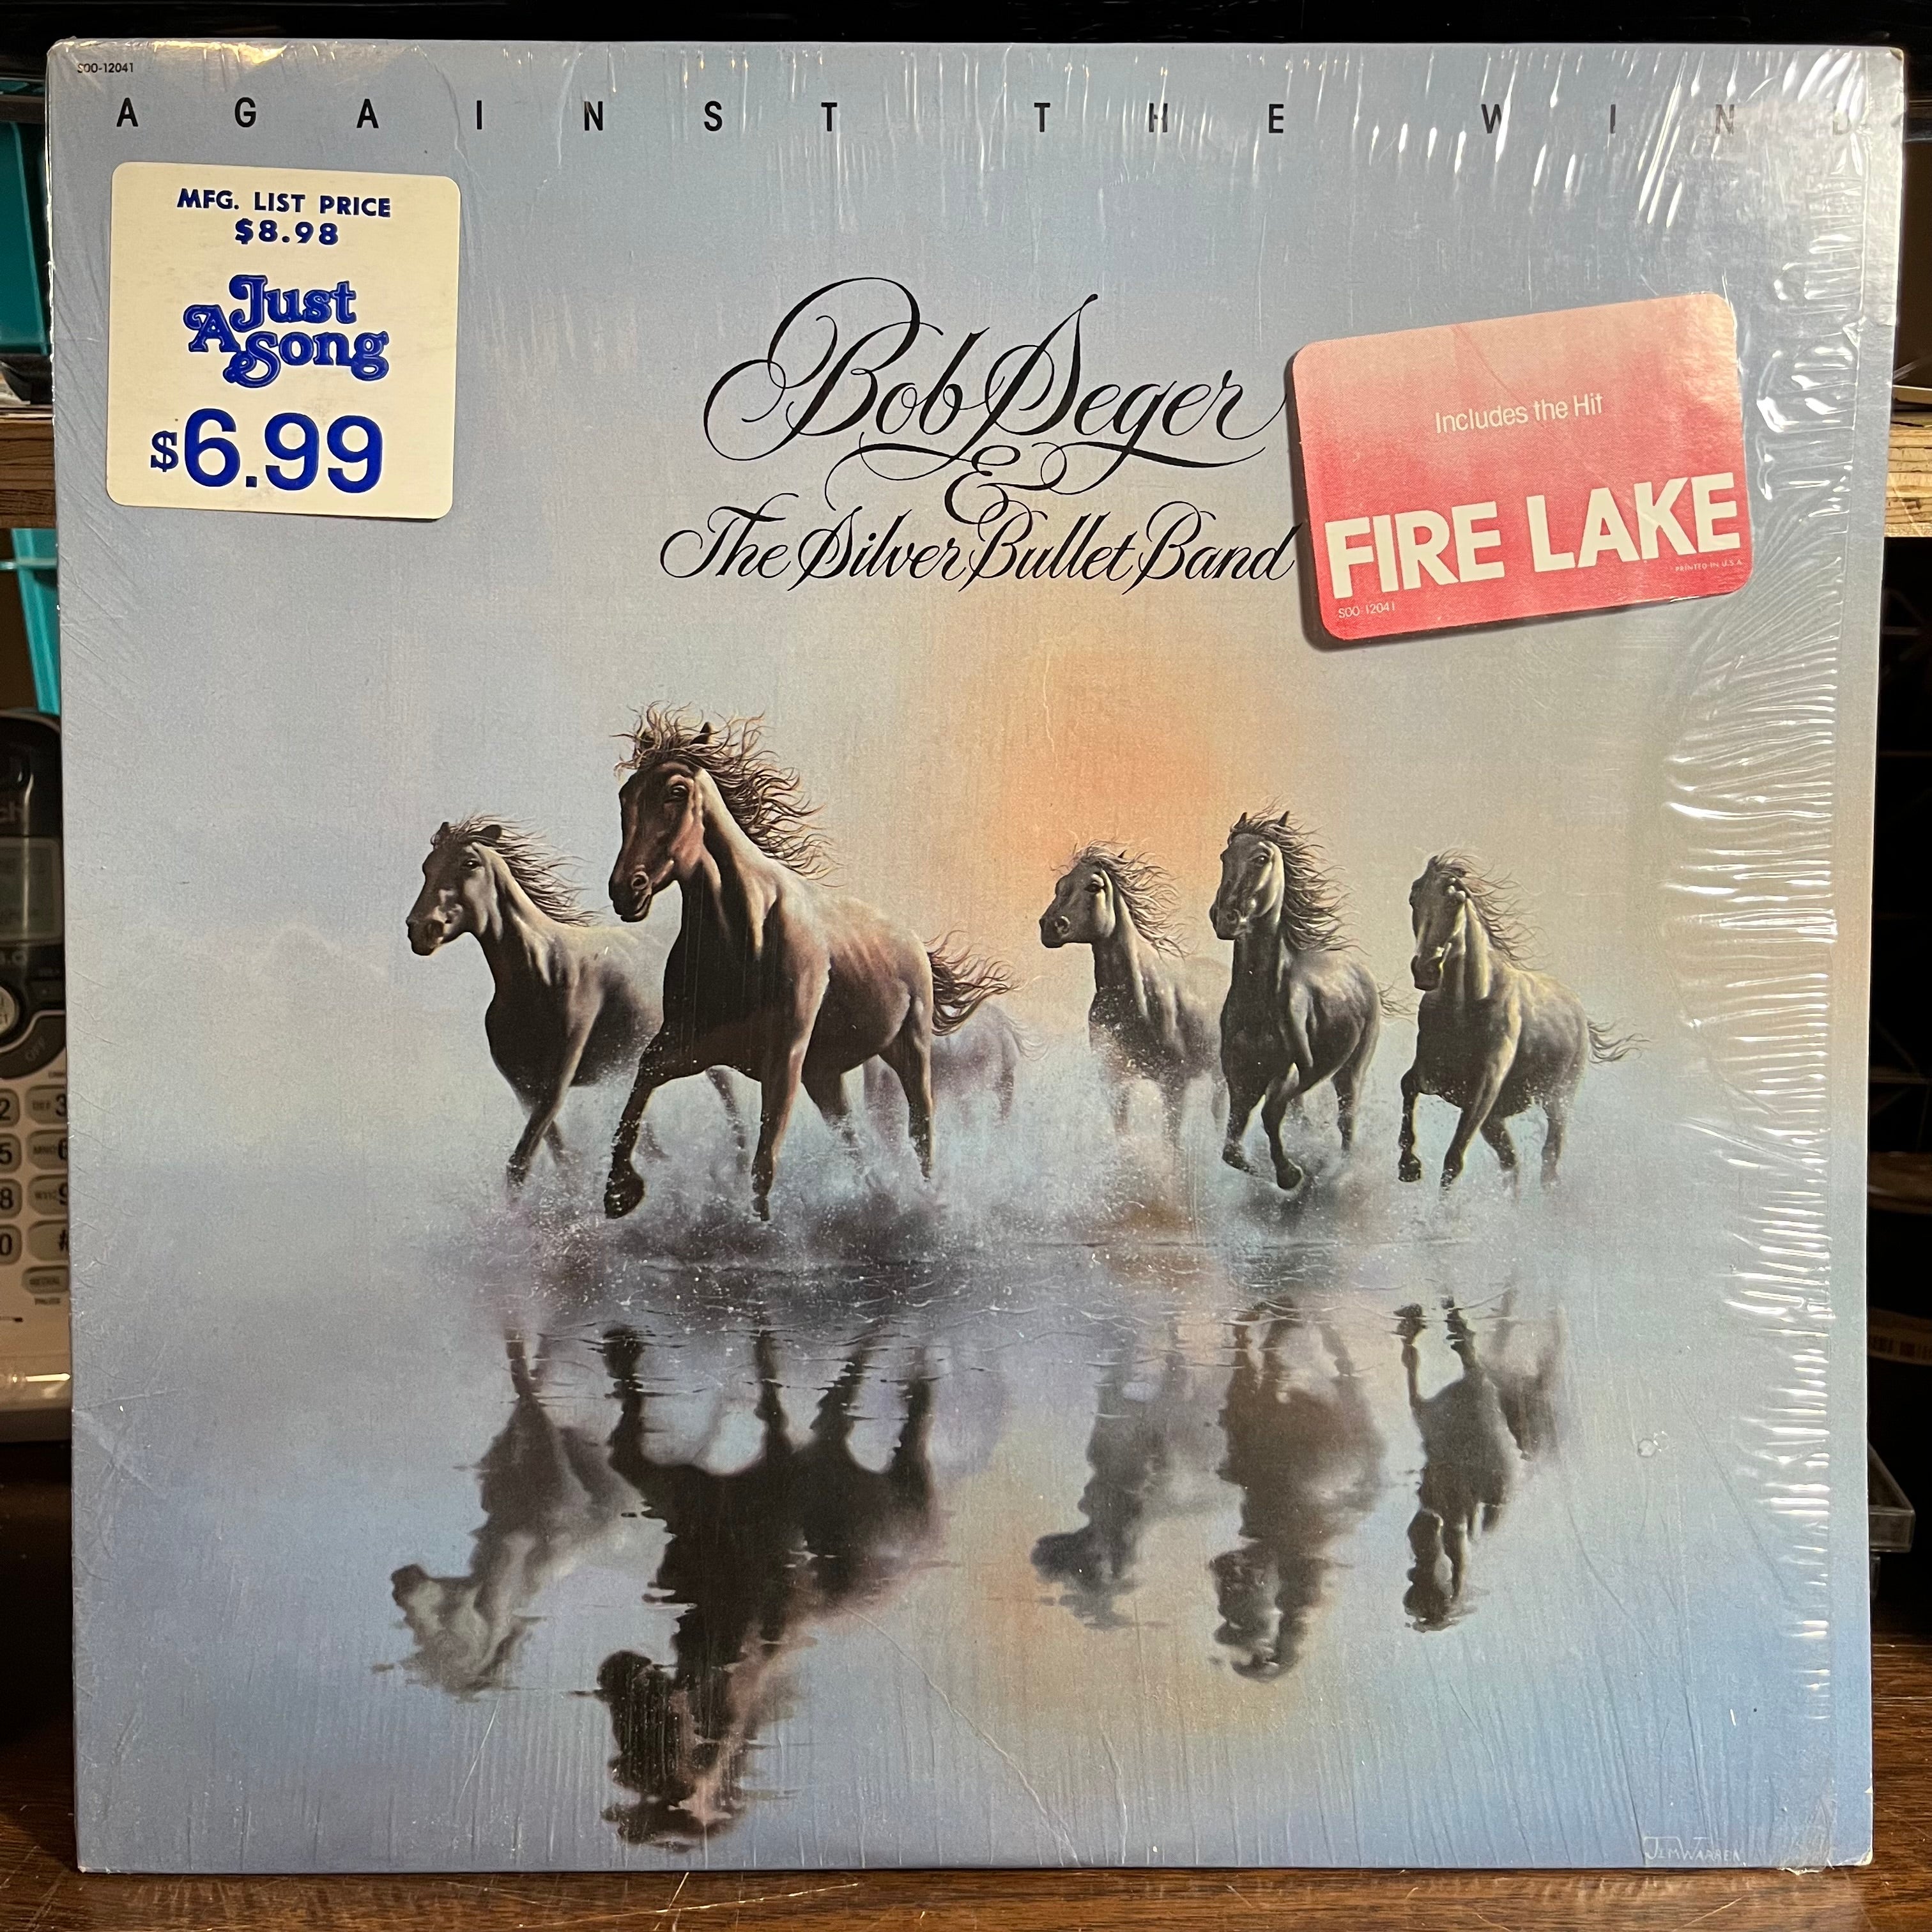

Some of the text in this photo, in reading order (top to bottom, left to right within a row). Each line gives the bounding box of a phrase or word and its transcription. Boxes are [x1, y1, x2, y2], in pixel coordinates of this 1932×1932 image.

[177, 188, 391, 217] MFG. LIST PRICE
[235, 218, 339, 245] $8.98
[229, 275, 356, 332] Just
[183, 305, 389, 388] A Song
[703, 277, 1287, 511] Bob Seger
[1436, 392, 1603, 434] Includes the Hit
[150, 408, 383, 494] $6.99
[660, 493, 1302, 595] The Silver Bullet Band
[1324, 472, 1741, 599] FIRE LAKE
[1365, 601, 1395, 614] 12041
[0, 1186, 13, 1210] 8
